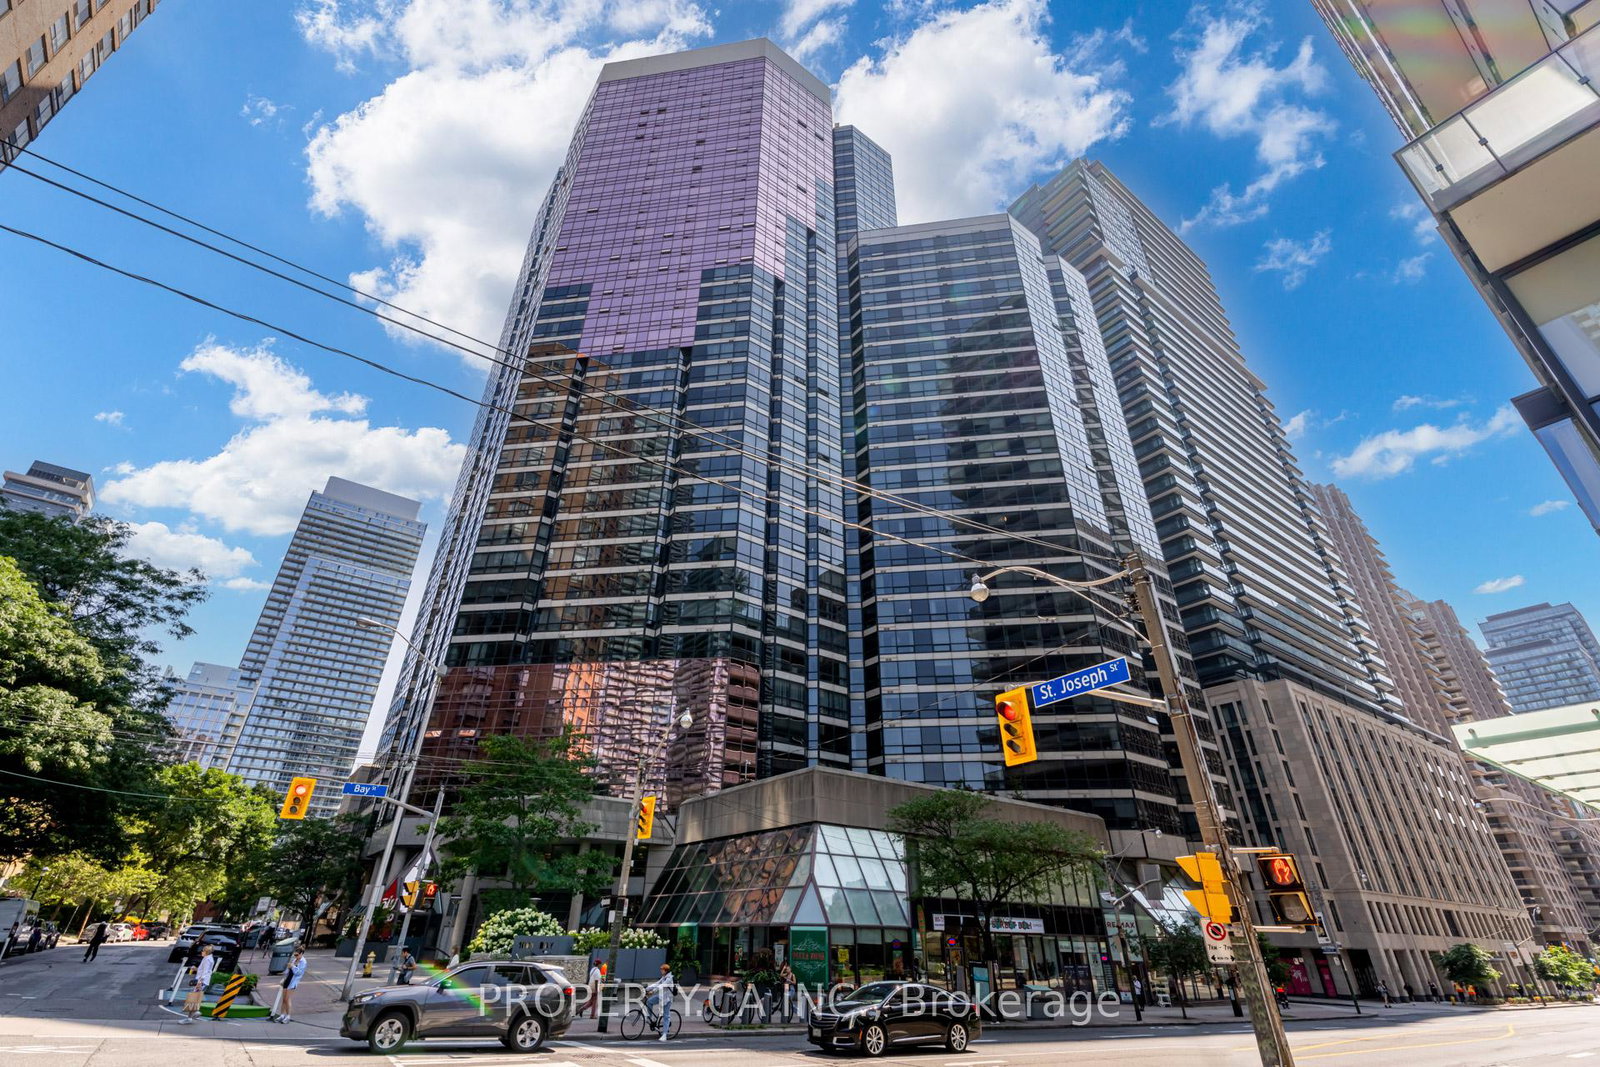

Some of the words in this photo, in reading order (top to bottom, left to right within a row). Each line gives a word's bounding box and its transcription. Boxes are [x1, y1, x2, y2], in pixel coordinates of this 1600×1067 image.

[1040, 684, 1057, 699] St.
[1061, 667, 1108, 694] Joseph
[1109, 663, 1118, 672] St
[353, 784, 370, 795] Bay
